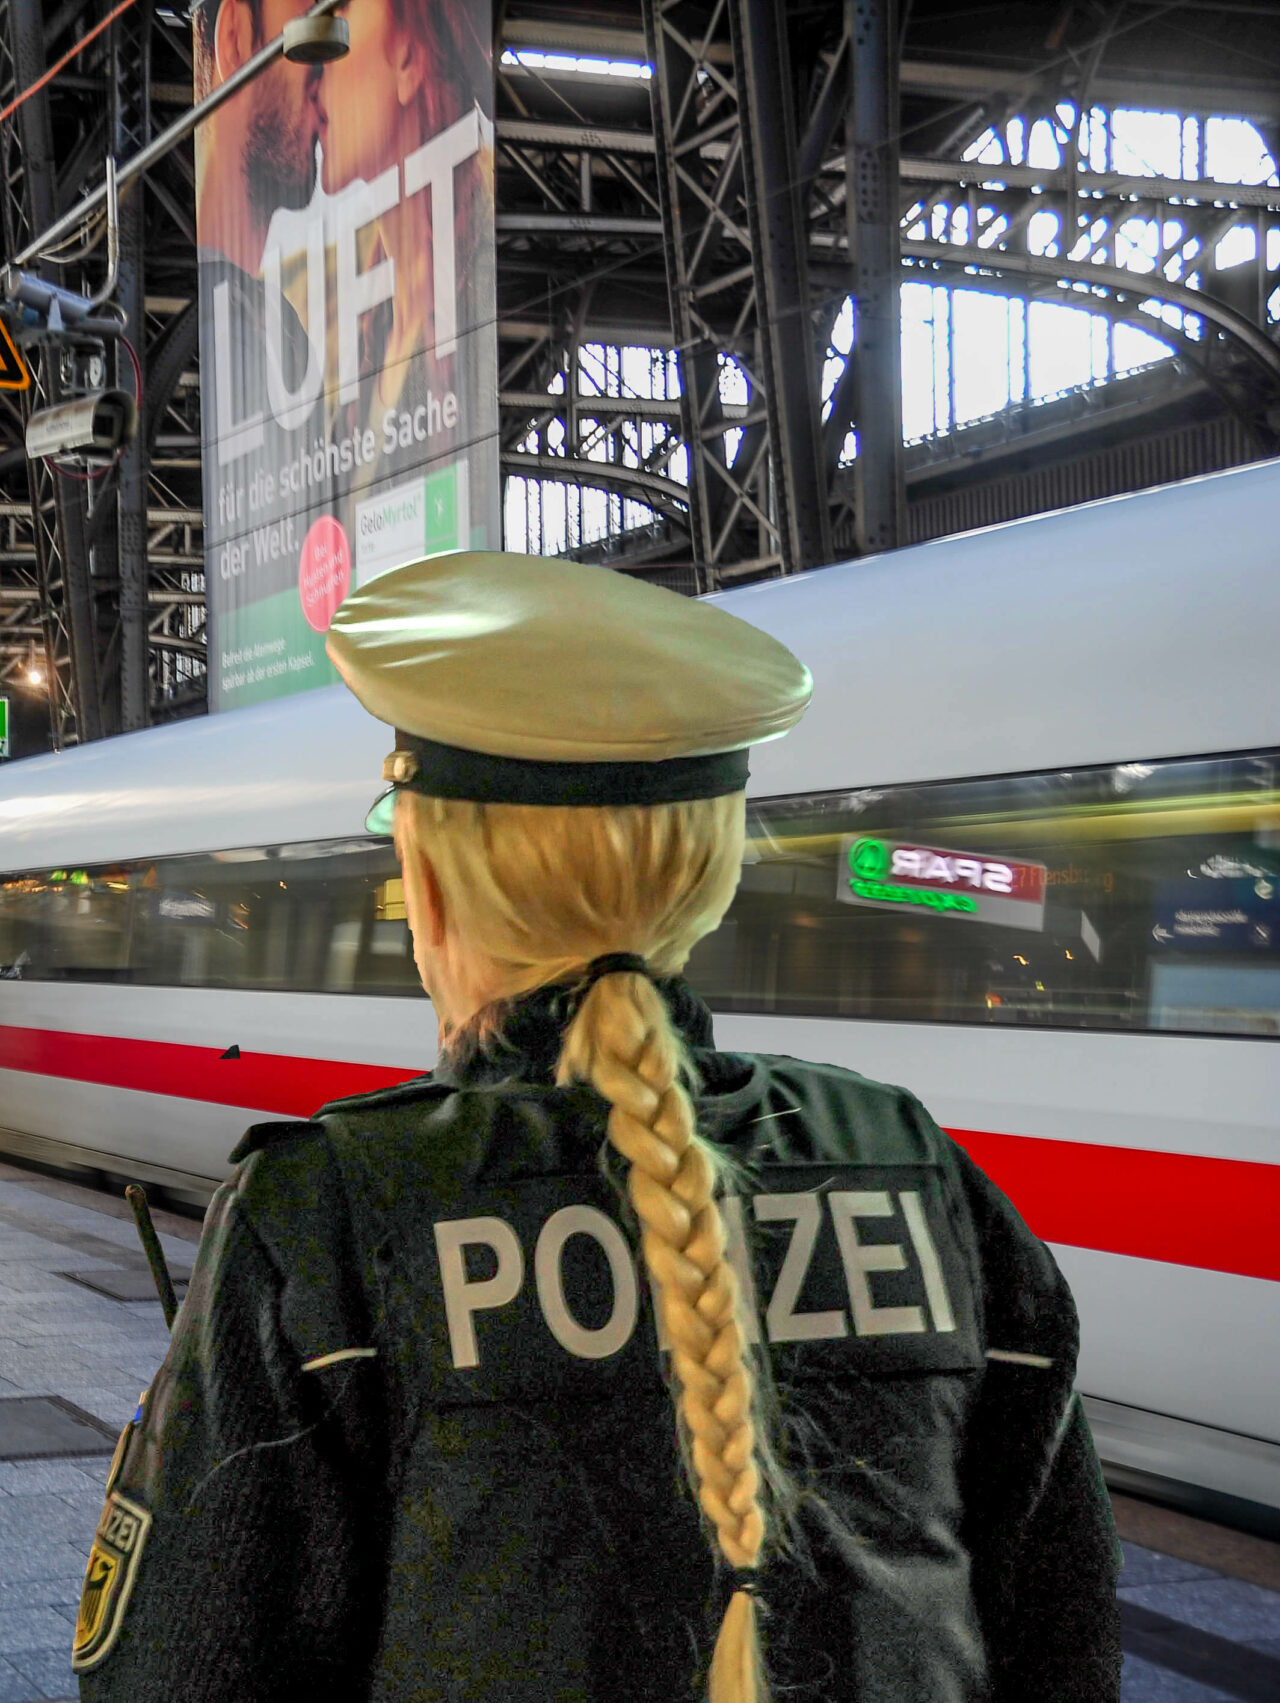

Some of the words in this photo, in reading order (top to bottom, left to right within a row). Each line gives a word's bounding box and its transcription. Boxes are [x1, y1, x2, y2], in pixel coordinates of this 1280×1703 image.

[214, 106, 479, 466] LUFT
[219, 481, 244, 526] für
[249, 468, 274, 511] die
[279, 426, 376, 498] schönste
[382, 391, 458, 455] Sache
[220, 541, 249, 580] der
[253, 517, 300, 567] Welt.
[433, 1190, 955, 1369] POIZEI
